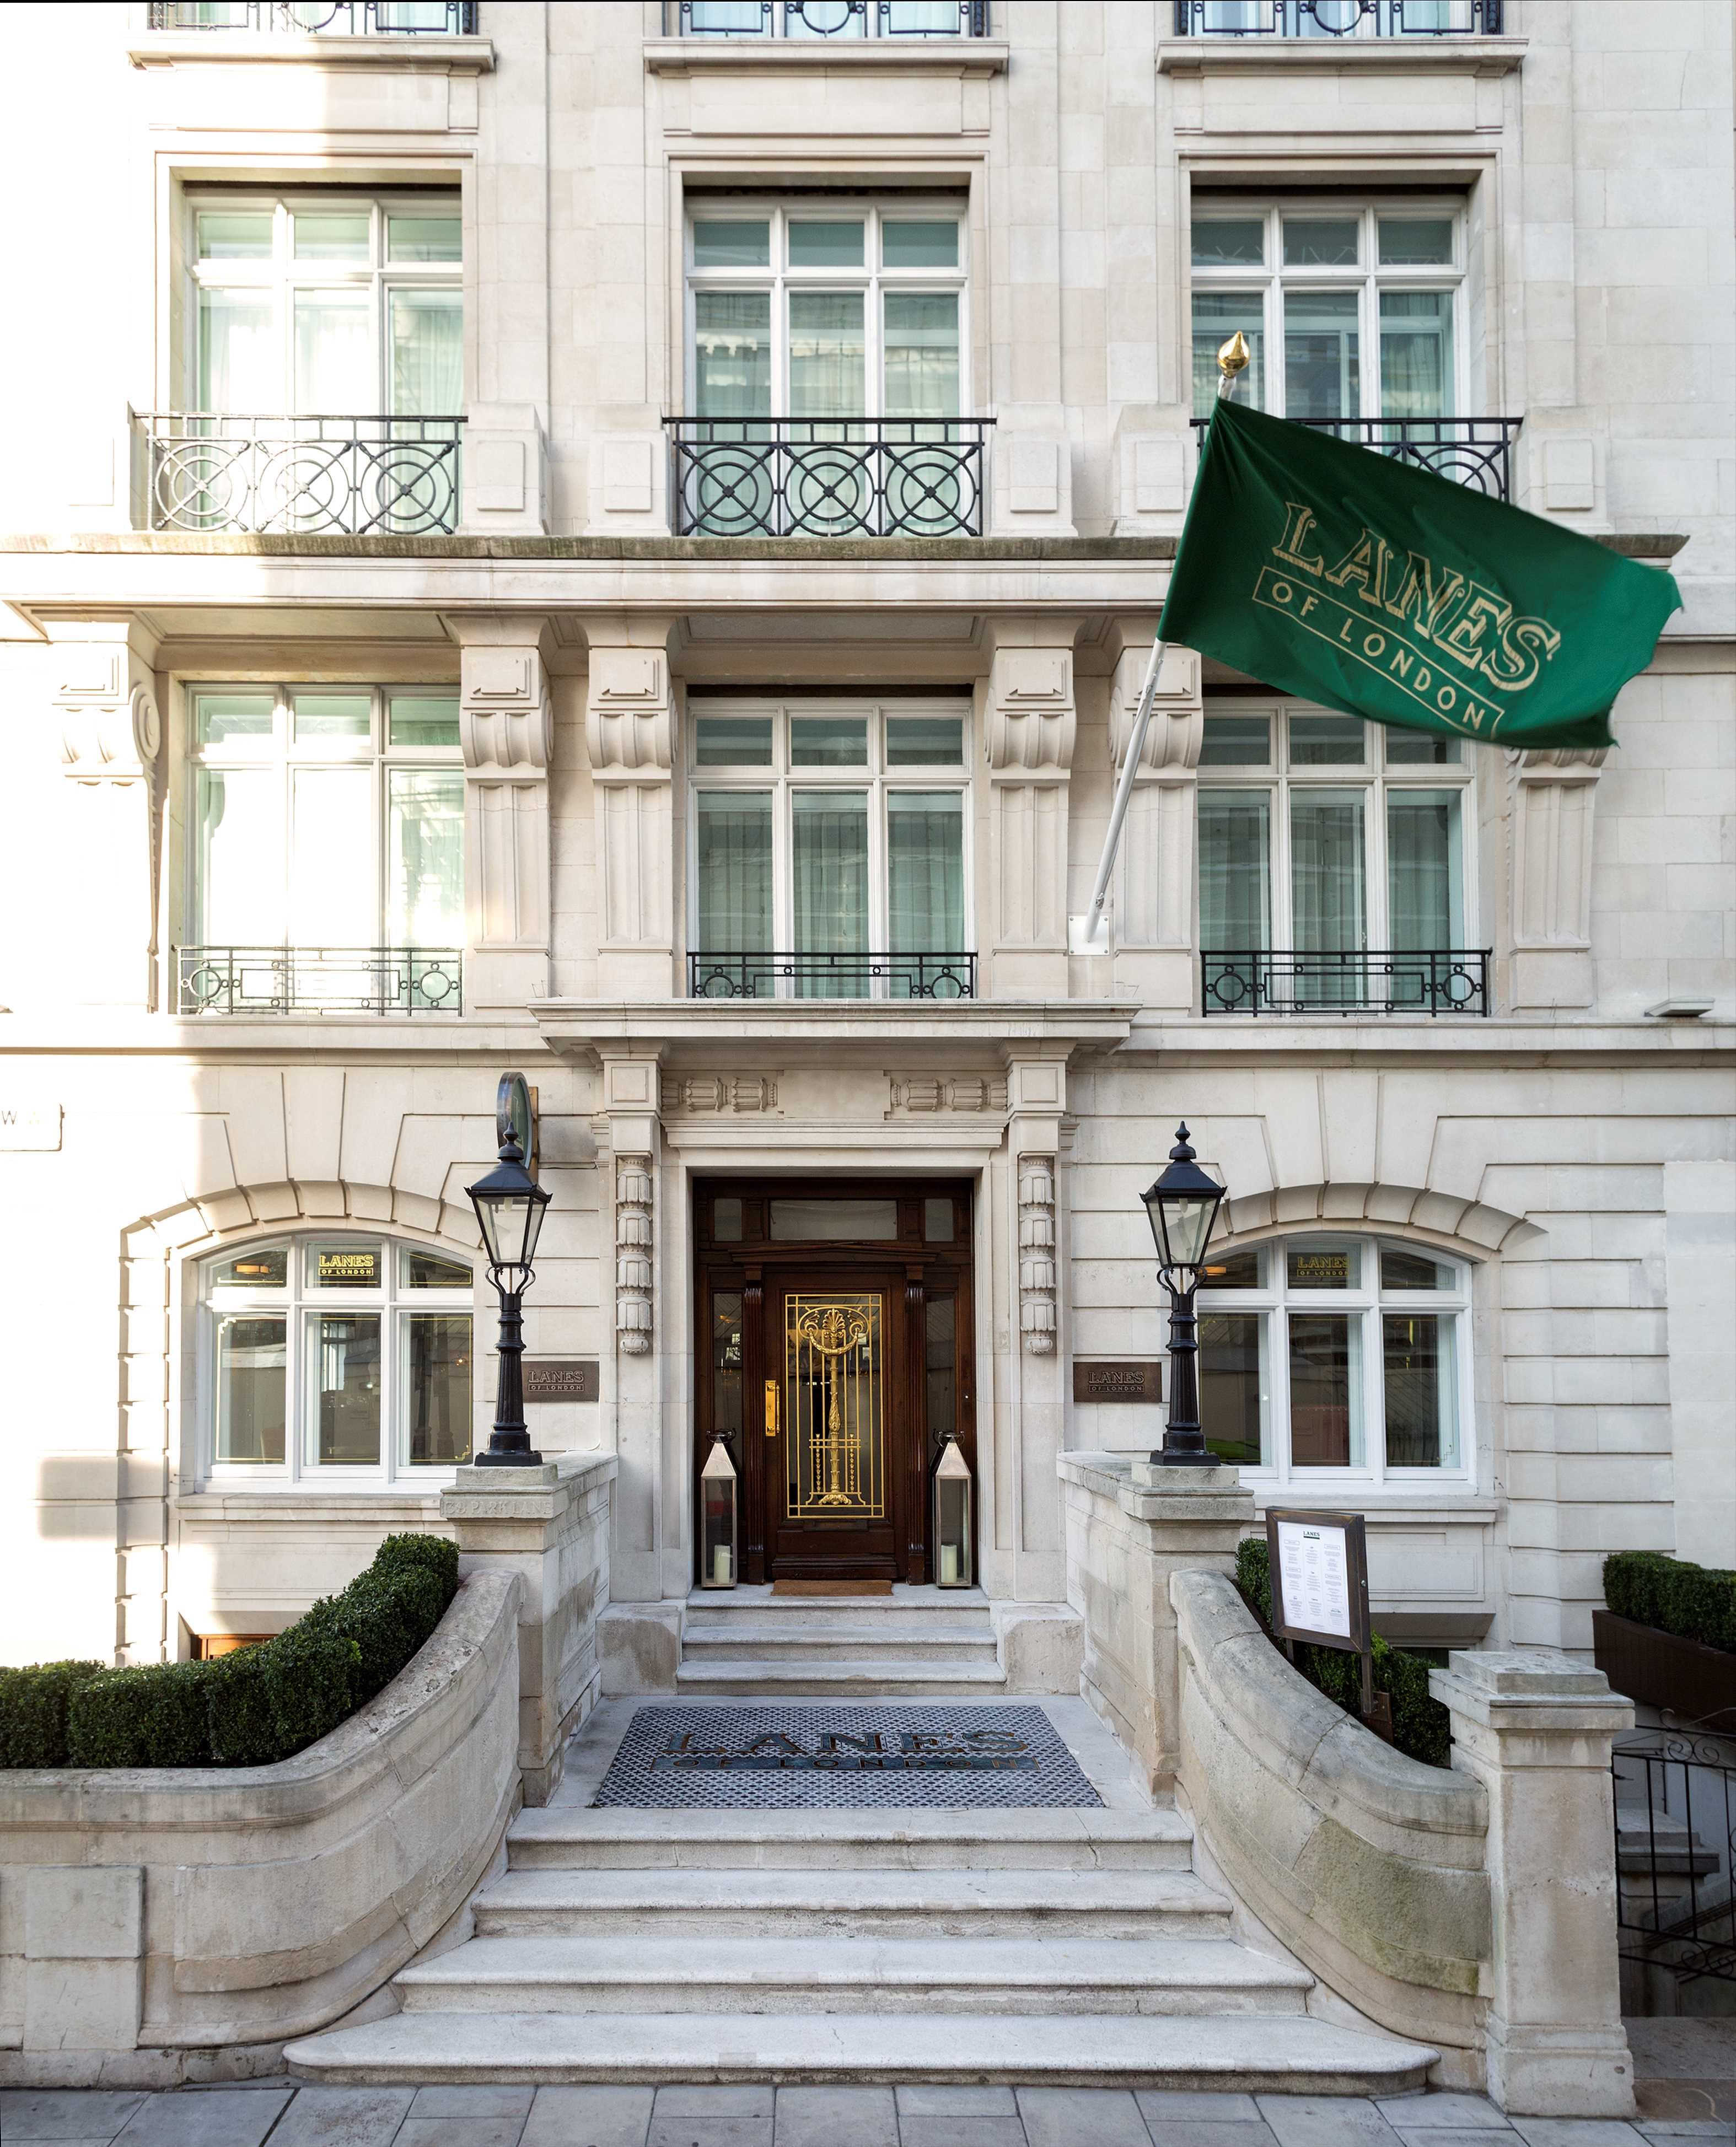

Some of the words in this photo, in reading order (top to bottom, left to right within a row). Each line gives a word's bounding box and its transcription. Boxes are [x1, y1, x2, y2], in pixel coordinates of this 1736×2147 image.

[1271, 501, 1561, 691] LANES
[1272, 582, 1319, 616] OF
[1339, 617, 1486, 730] LONDON
[319, 1254, 374, 1267] LANES
[1298, 1256, 1350, 1268] LANES
[528, 1370, 584, 1383] LANES
[1088, 1371, 1145, 1384] LANES
[471, 1500, 508, 1515] PARK
[512, 1500, 552, 1515] LANE
[661, 1732, 1028, 1753] LANES
[673, 1758, 734, 1768] OF
[780, 1757, 1018, 1768] LONDON
